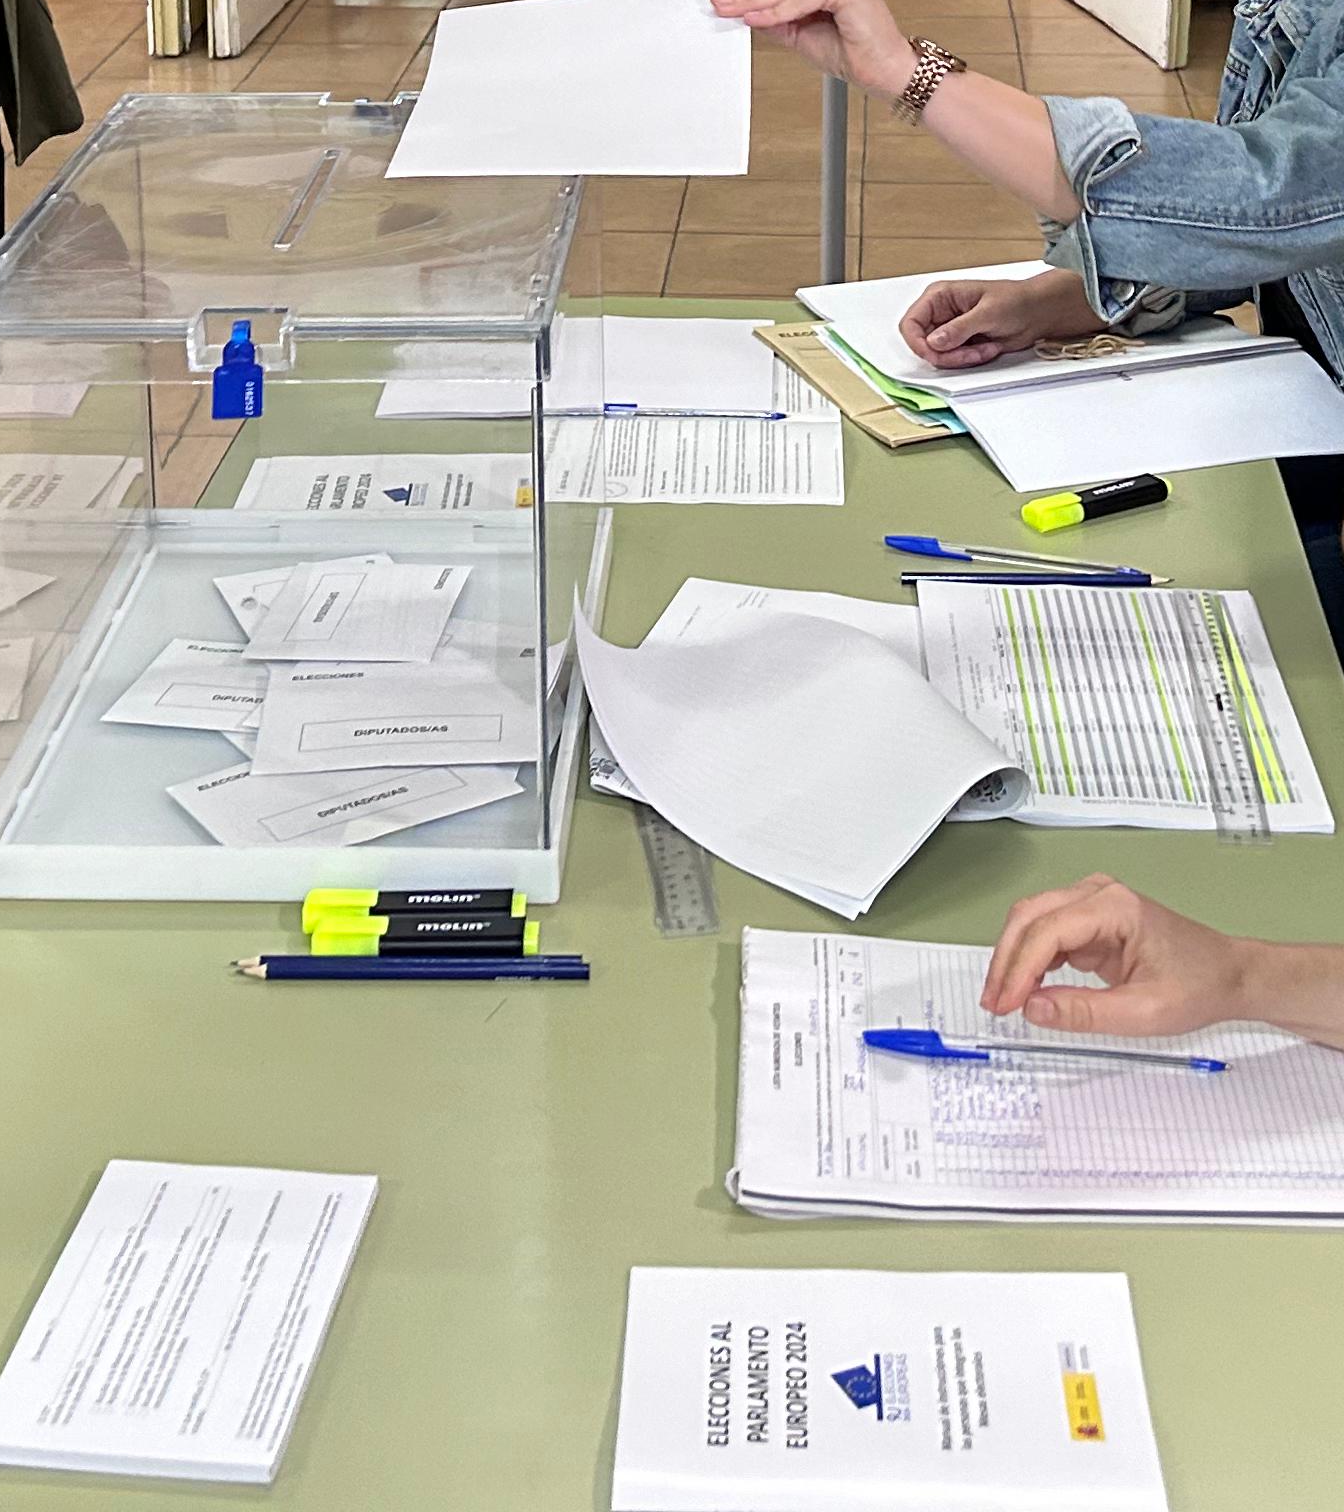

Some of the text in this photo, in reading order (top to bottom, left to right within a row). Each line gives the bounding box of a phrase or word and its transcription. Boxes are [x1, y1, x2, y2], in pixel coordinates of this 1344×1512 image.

[292, 671, 365, 681] ELECCIONES
[353, 724, 449, 738] DIPUTADOS/AS
[317, 786, 409, 818] DIPUTADOS/AS
[707, 1320, 732, 1447] ELECCIONES AL
[746, 1325, 769, 1444] PARLAMENTO
[785, 1320, 808, 1449] EUROPEO 2024
